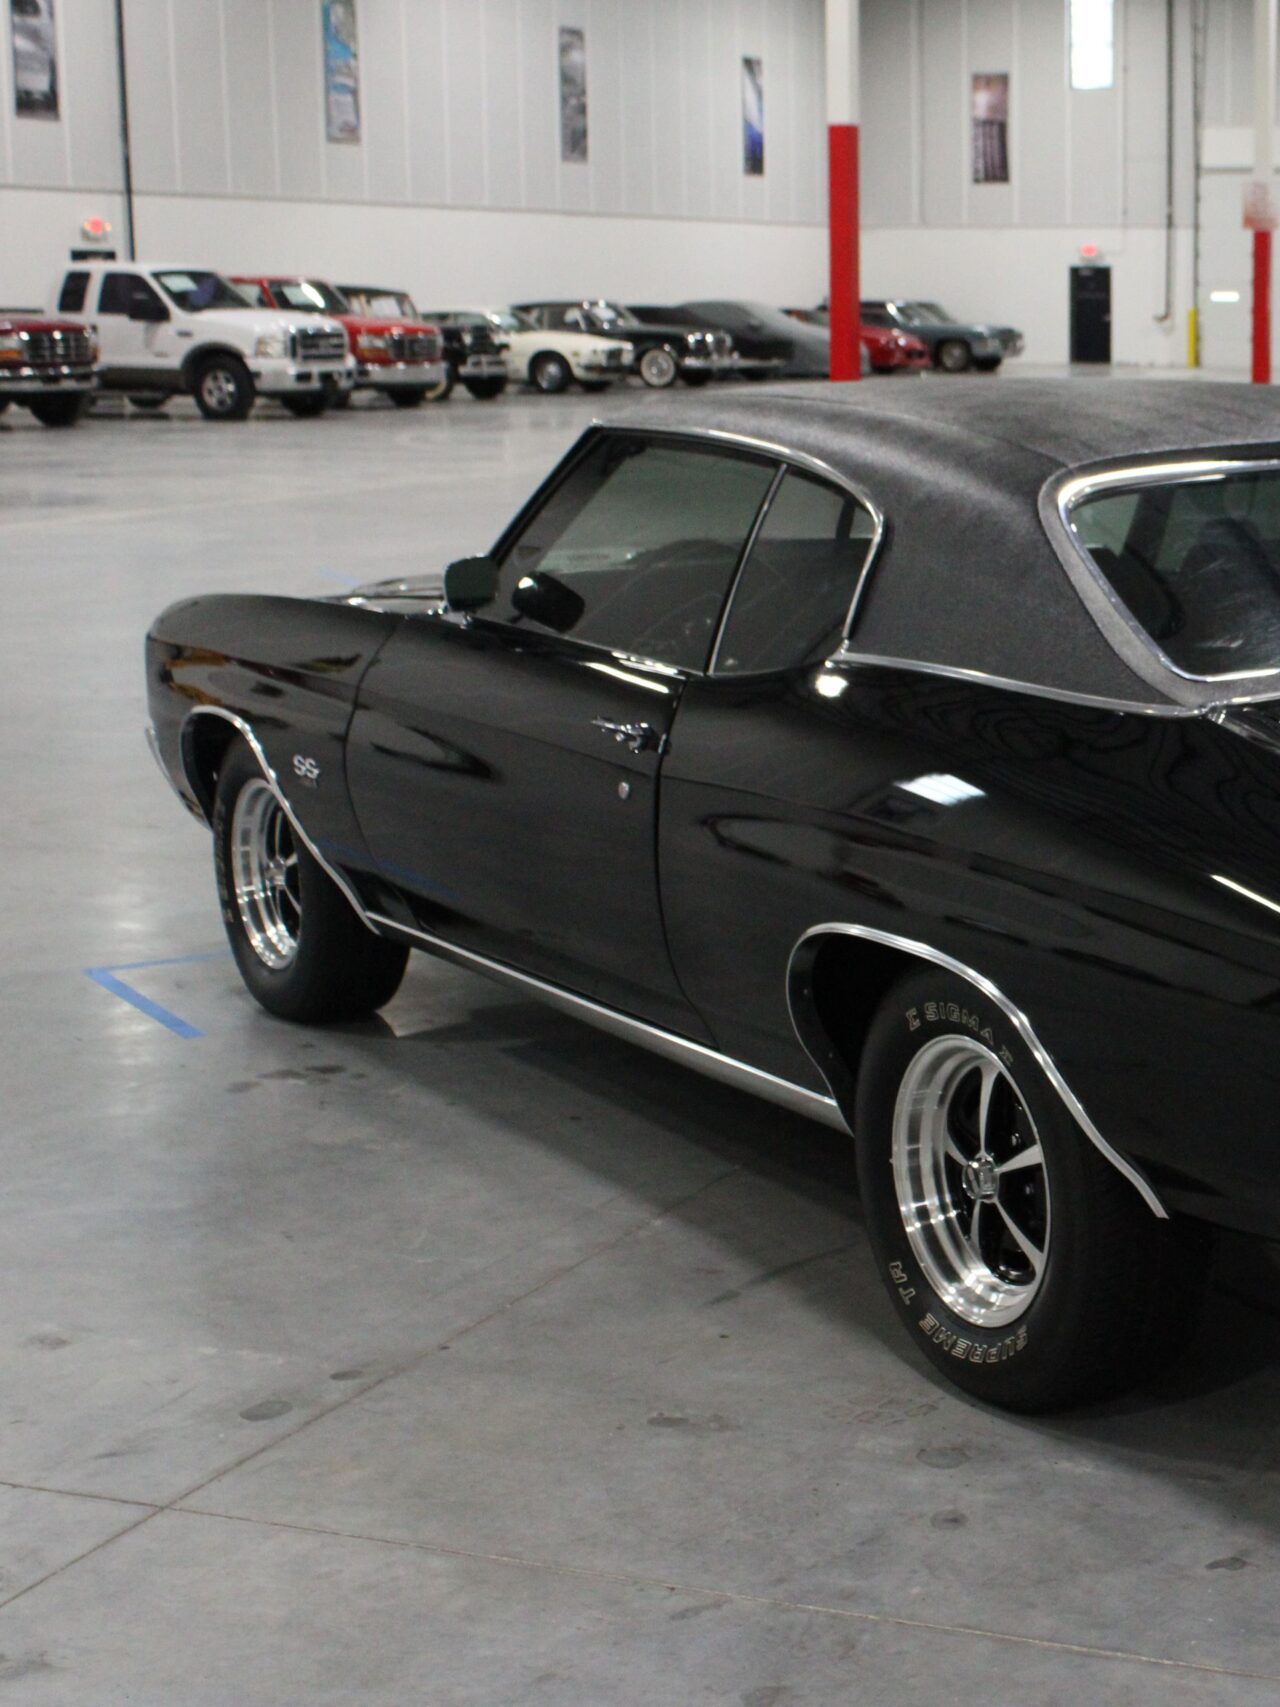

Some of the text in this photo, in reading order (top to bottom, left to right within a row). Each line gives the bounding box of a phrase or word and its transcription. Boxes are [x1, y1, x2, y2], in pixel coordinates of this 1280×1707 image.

[292, 753, 320, 779] SS
[924, 1001, 995, 1047] SIGMA
[918, 1312, 1029, 1364] SUPREME
